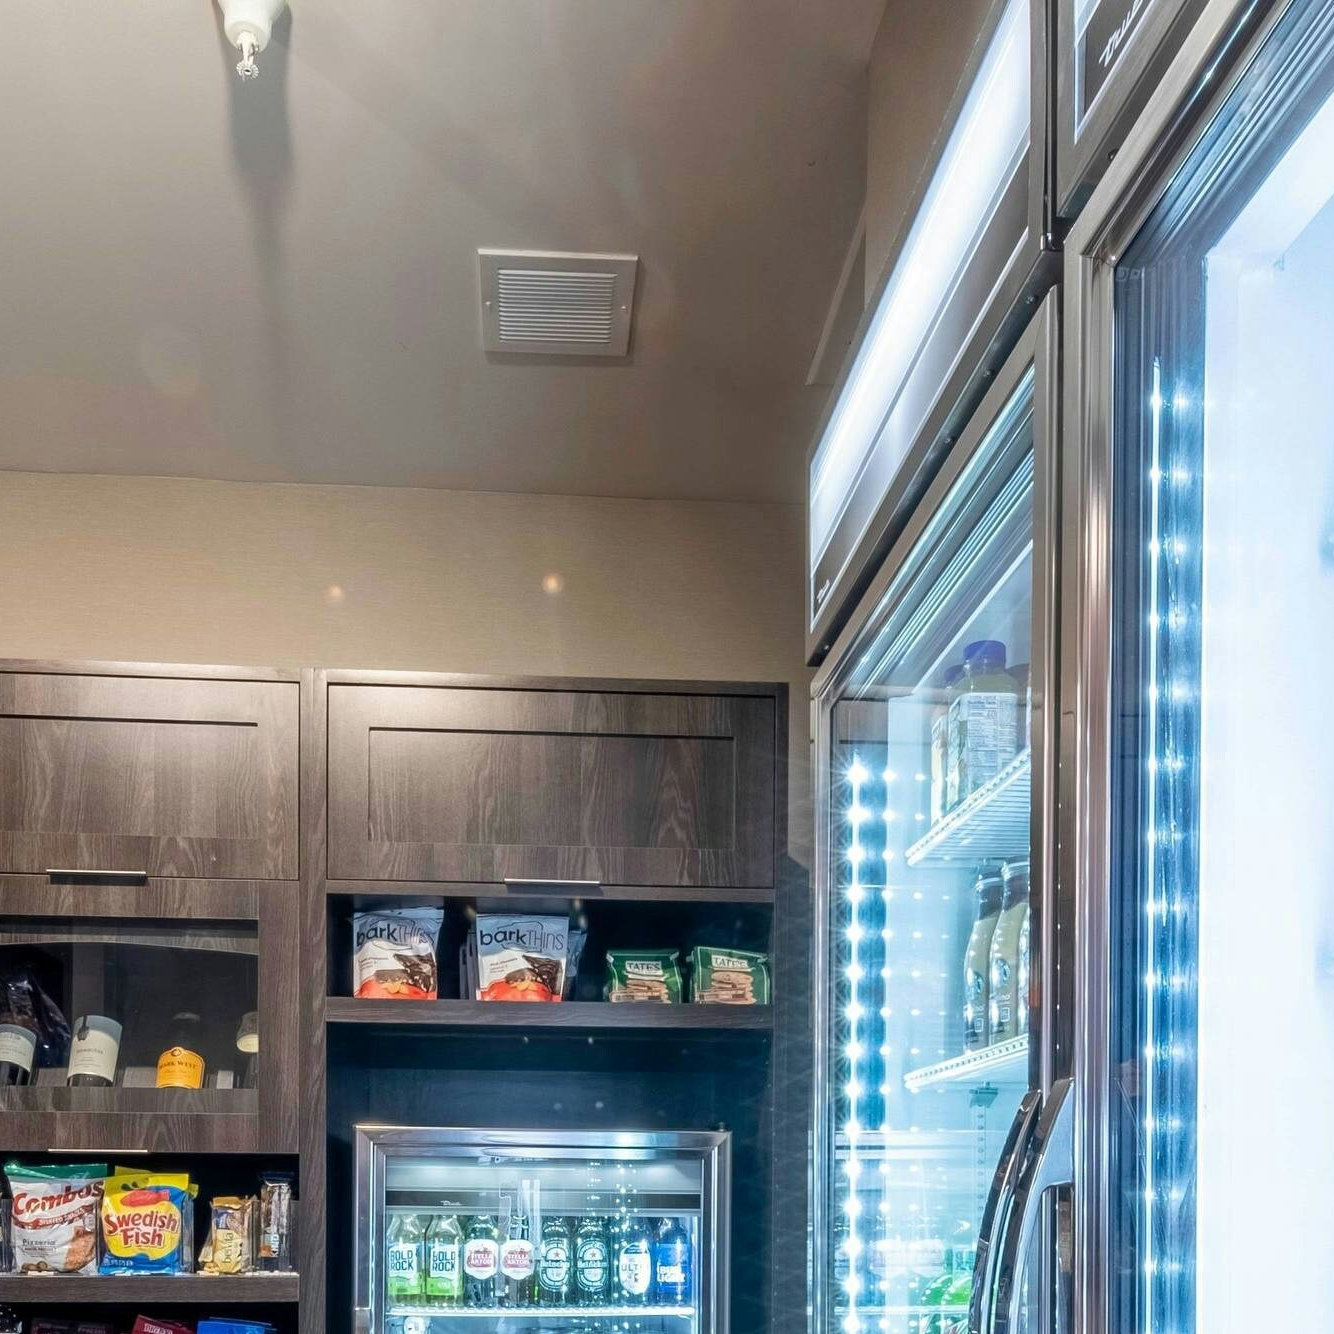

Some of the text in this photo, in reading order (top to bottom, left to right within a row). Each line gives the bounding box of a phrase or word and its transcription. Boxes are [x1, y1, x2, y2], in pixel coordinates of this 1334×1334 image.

[12, 1180, 104, 1216] Combos
[103, 1210, 178, 1235] Swedish
[121, 1227, 163, 1248] Fish
[390, 1261, 414, 1271] ROCK
